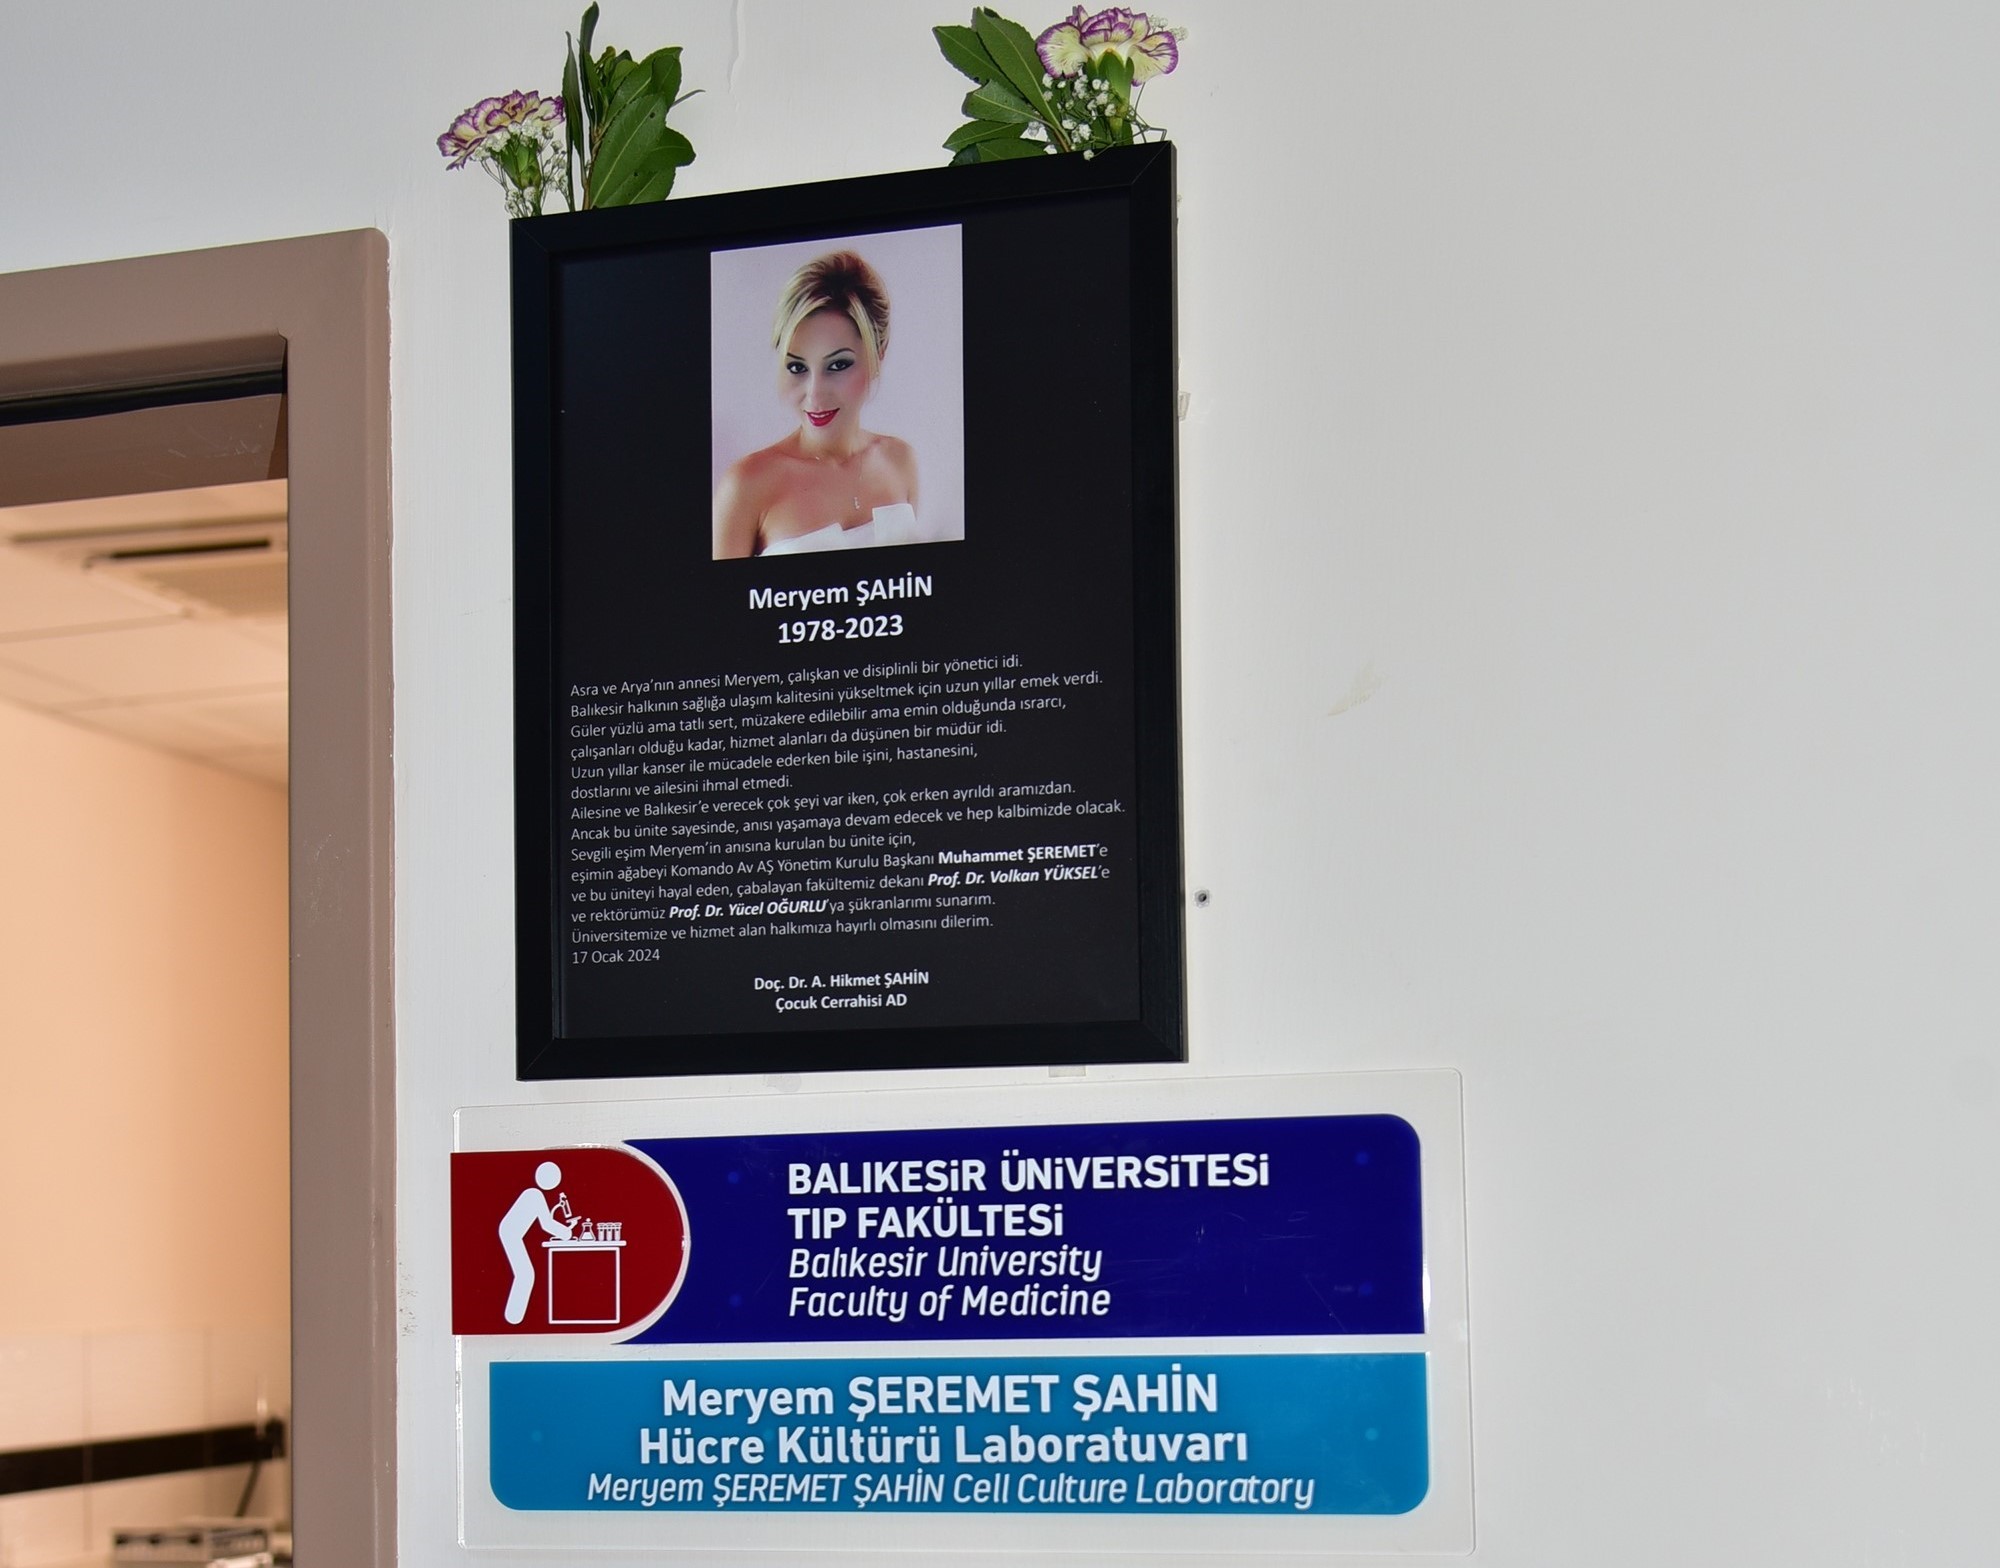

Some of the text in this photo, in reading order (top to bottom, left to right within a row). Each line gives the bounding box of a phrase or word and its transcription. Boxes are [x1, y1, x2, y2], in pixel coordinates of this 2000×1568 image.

[749, 571, 932, 611] Meryem ŞAHİN
[778, 614, 904, 644] 1978-2023
[570, 684, 599, 697] Asra
[602, 684, 617, 695] ve
[678, 674, 721, 690] annesi
[724, 673, 784, 688] Meryem,
[787, 667, 840, 686] çalışkan
[843, 668, 859, 679] ve
[862, 661, 918, 679] disiplinli
[921, 660, 940, 674] bir
[943, 655, 998, 675] yönetici
[1002, 654, 1023, 668] idi.
[571, 670, 1103, 718] Balıkesir halkının sağlığa ulaşım kalitesini yükseltmek için uzun yıllar emek verdi.
[570, 697, 1066, 739] Güler yüzlü ama tatlı sert, müzakere edilebilir ama emin olduğunda ısrarcı,
[570, 719, 1007, 762] çalışanları olduğu kadar, hizmet alanları da düşünen bir müdür idi.
[571, 742, 978, 780] Uzun yıllar kanser ile mücadele ederken bile işini, hastanesini,
[571, 774, 793, 800] dostlarını ve ailesini ihmal etmedi.
[570, 798, 1125, 840] Ancak bu ünite sayesinde, anısı yaşamaya devam edecek ve hep kalbimizde olacak.
[571, 846, 611, 864] Sevgili
[614, 845, 646, 862] eşim
[724, 841, 771, 854] anısına
[775, 836, 825, 851] kurulan
[828, 835, 846, 849] bu
[849, 833, 885, 848] ünite
[888, 831, 916, 849] için,
[571, 868, 614, 884] eşimin
[617, 865, 667, 882] ağabeyi
[671, 861, 734, 877] Komando
[737, 861, 754, 874] Av
[756, 859, 774, 876] AŞ
[777, 858, 832, 872] Yönetim
[836, 854, 879, 869] Kurulu
[883, 852, 934, 870] Başkanı
[938, 848, 1024, 865] Muhammet
[571, 892, 587, 902] ve
[590, 888, 606, 902] bu
[611, 885, 654, 902] üniteyi
[658, 884, 692, 901] hayal
[696, 883, 733, 897] eden,
[736, 880, 802, 898] çabalayan
[806, 877, 875, 892] fakültemiz
[879, 874, 924, 889] dekanı
[927, 871, 961, 889] Prof.
[965, 871, 985, 885] Dr.
[990, 868, 1040, 884] Volkan
[571, 912, 587, 923] ve
[590, 906, 666, 922] rektörümüz
[669, 903, 701, 921] Prof.
[704, 904, 724, 918] Dr.
[728, 900, 765, 916] Yücel
[848, 895, 932, 914] şükranlarımı
[935, 895, 996, 908] sunarım.
[572, 914, 994, 944] Üniversitemize ve hizmet alan halkımıza hayırlı olmasını dilerim.
[572, 948, 661, 965] 17 Ocak 2024
[754, 968, 929, 993] Doç. Dr. A. Hikmet ŞAHİN
[775, 993, 908, 1014] Çocuk Cerrahisi AD
[787, 1207, 847, 1240] TIP
[789, 1243, 1103, 1282] Balıkesir University
[789, 1282, 1111, 1323] Faculty of Medicine
[663, 1362, 1218, 1425] Meryem ŞEREMET ŞAHİN
[640, 1424, 1248, 1465] Hücre Kültürü Laboratuvarı
[587, 1468, 1315, 1510] Meryem ŞEREMET ŞAHİN Cell Culture Laboratory
